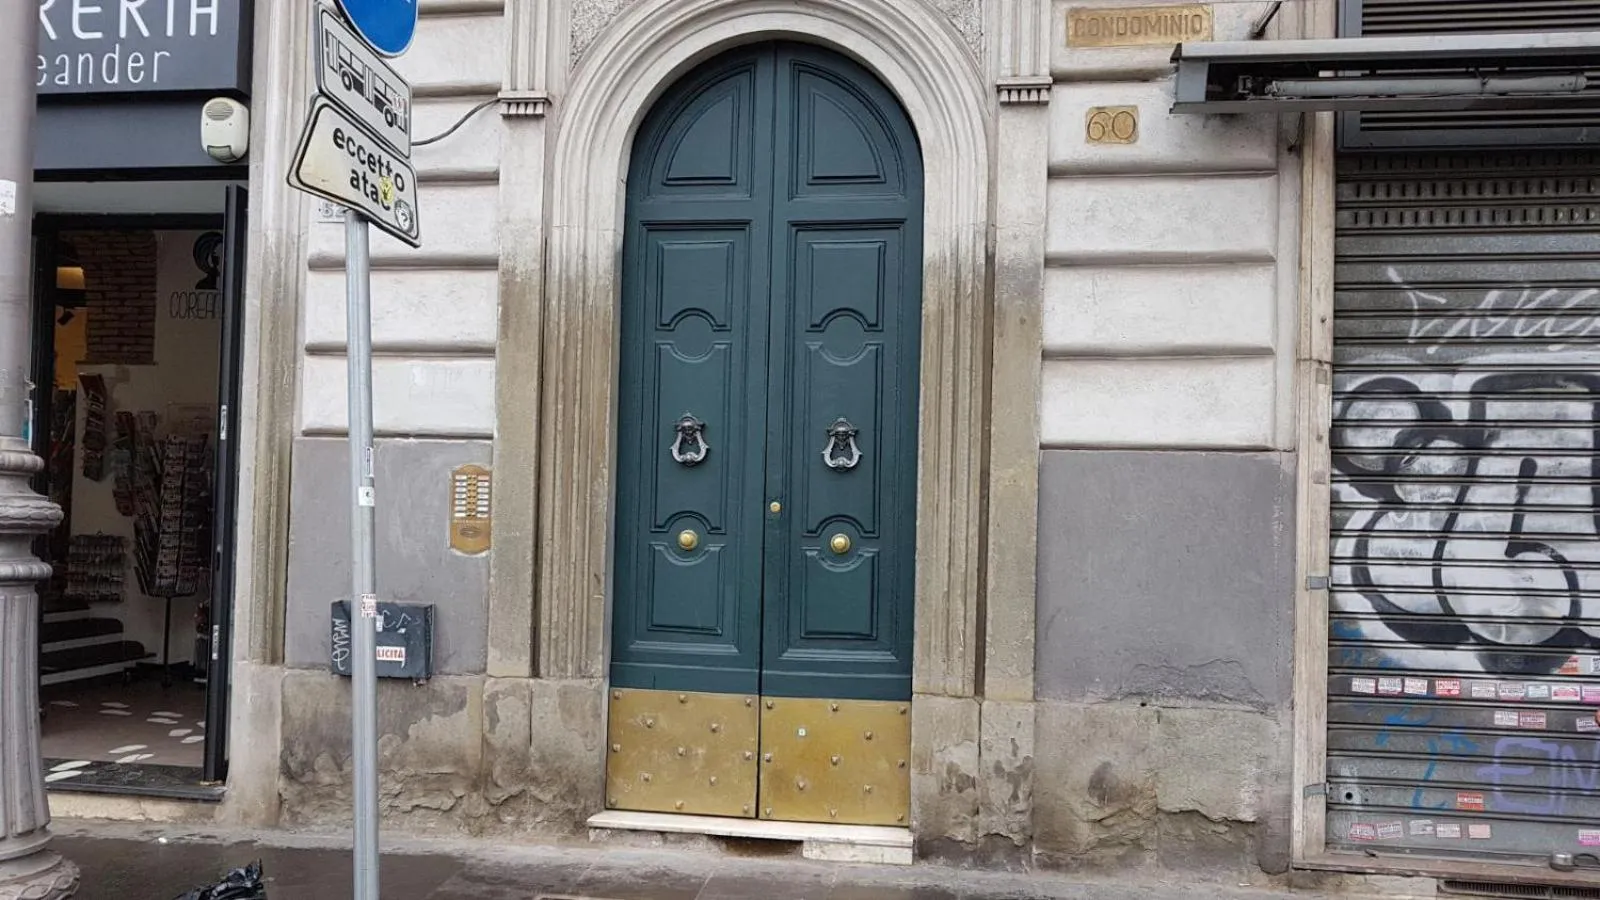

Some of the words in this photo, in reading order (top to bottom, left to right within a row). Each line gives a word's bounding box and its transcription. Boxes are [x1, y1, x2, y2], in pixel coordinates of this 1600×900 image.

[1073, 14, 1203, 37] CONDOMINIO
[1087, 110, 1136, 141] 60
[333, 127, 405, 192] eccetto
[170, 291, 223, 319] COREA
